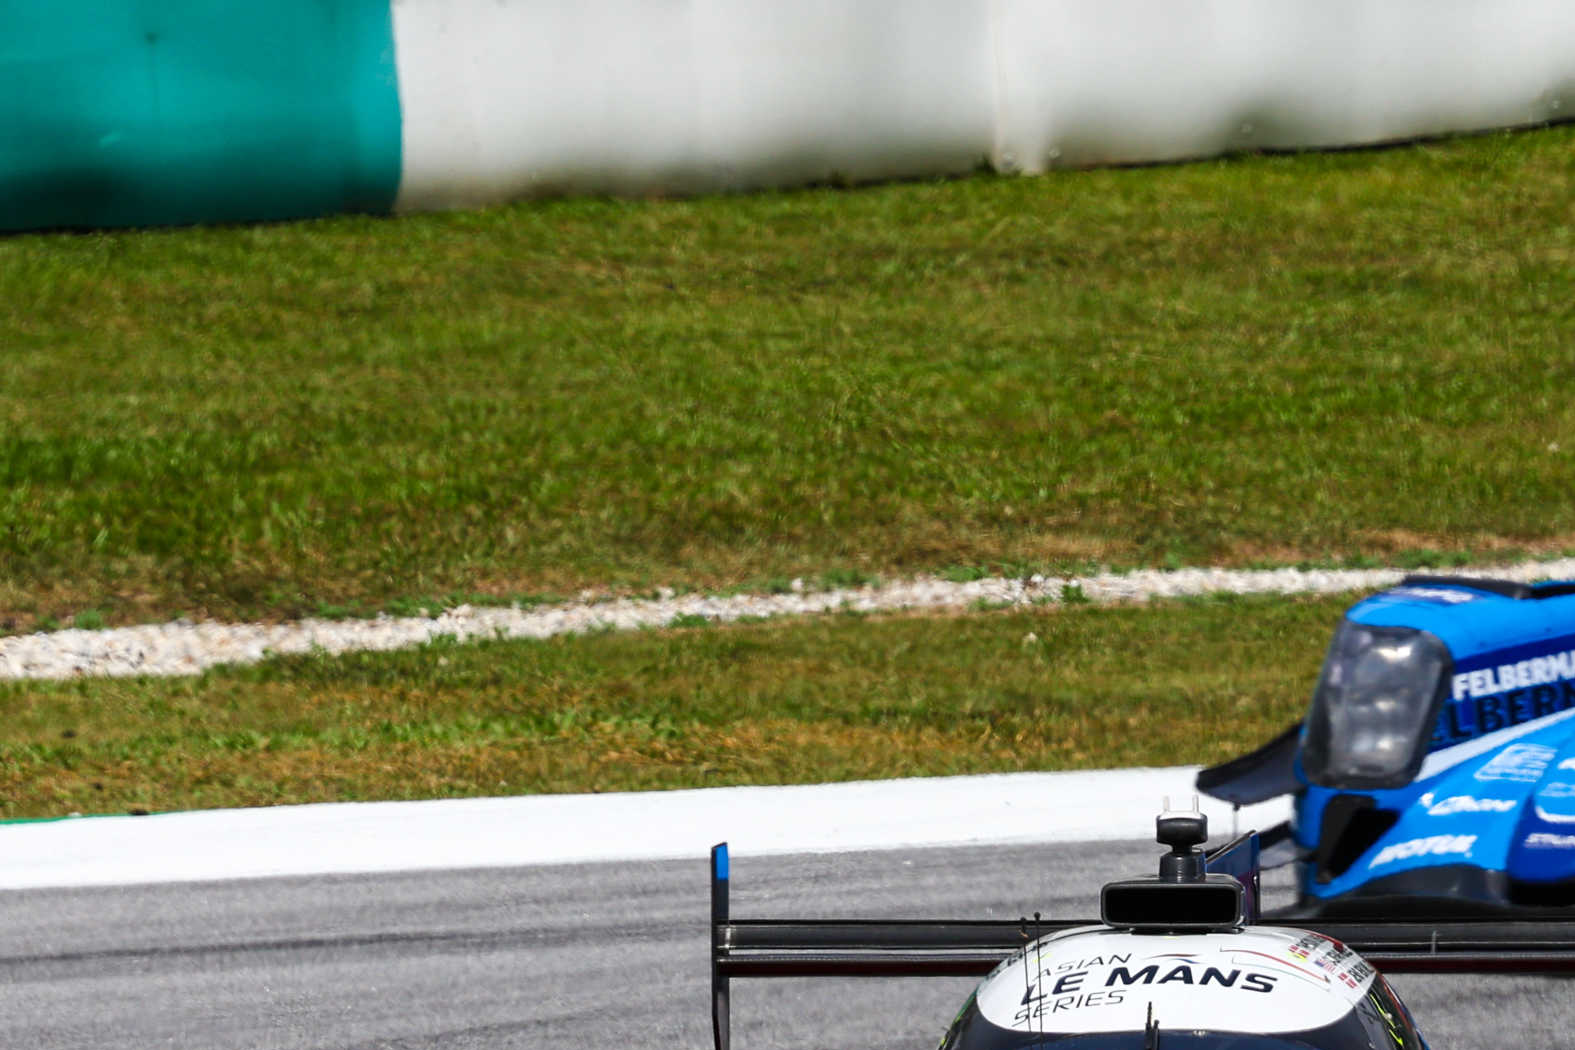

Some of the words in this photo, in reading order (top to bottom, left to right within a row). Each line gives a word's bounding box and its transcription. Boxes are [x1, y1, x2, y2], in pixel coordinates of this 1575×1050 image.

[1020, 971, 1089, 1006] LE
[1105, 965, 1278, 993] MANS
[1032, 953, 1132, 982] ASIAN
[1012, 990, 1127, 1027] SERIES
